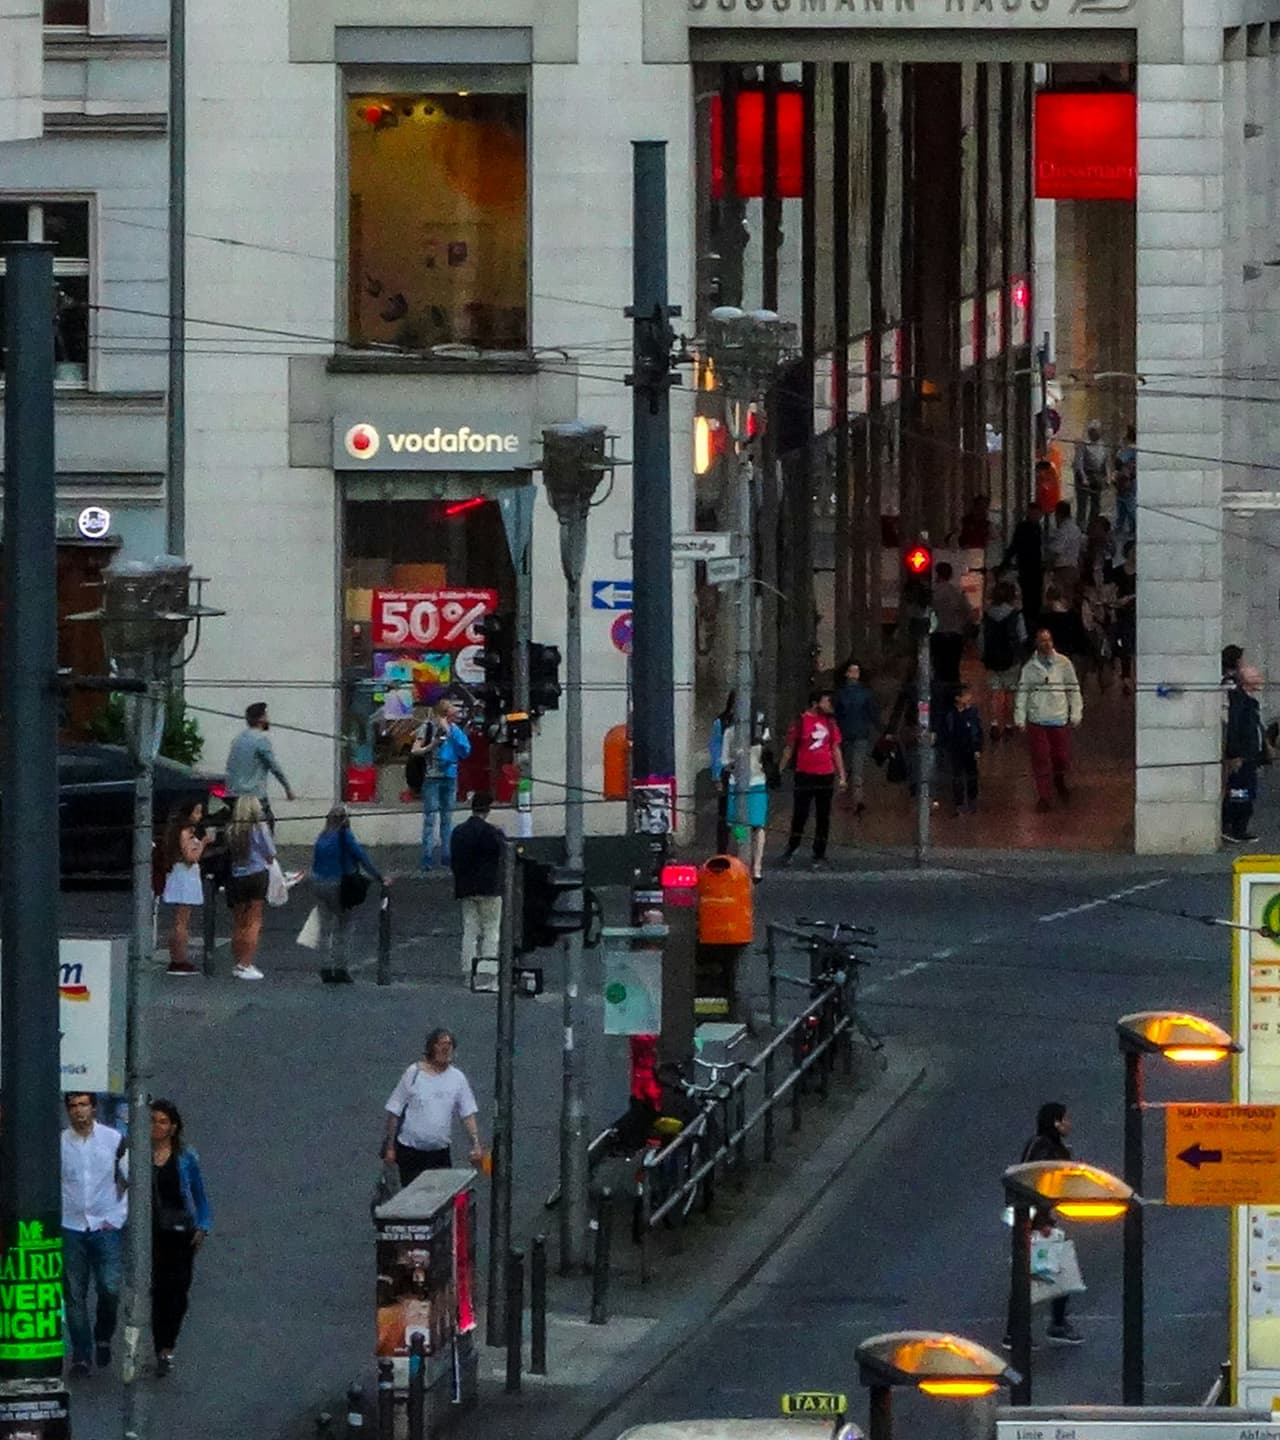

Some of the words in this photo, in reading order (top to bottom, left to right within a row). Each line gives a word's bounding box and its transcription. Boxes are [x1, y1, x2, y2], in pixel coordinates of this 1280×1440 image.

[387, 426, 520, 452] vodafone
[380, 600, 487, 644] 50%
[794, 1396, 837, 1411] TAXI
